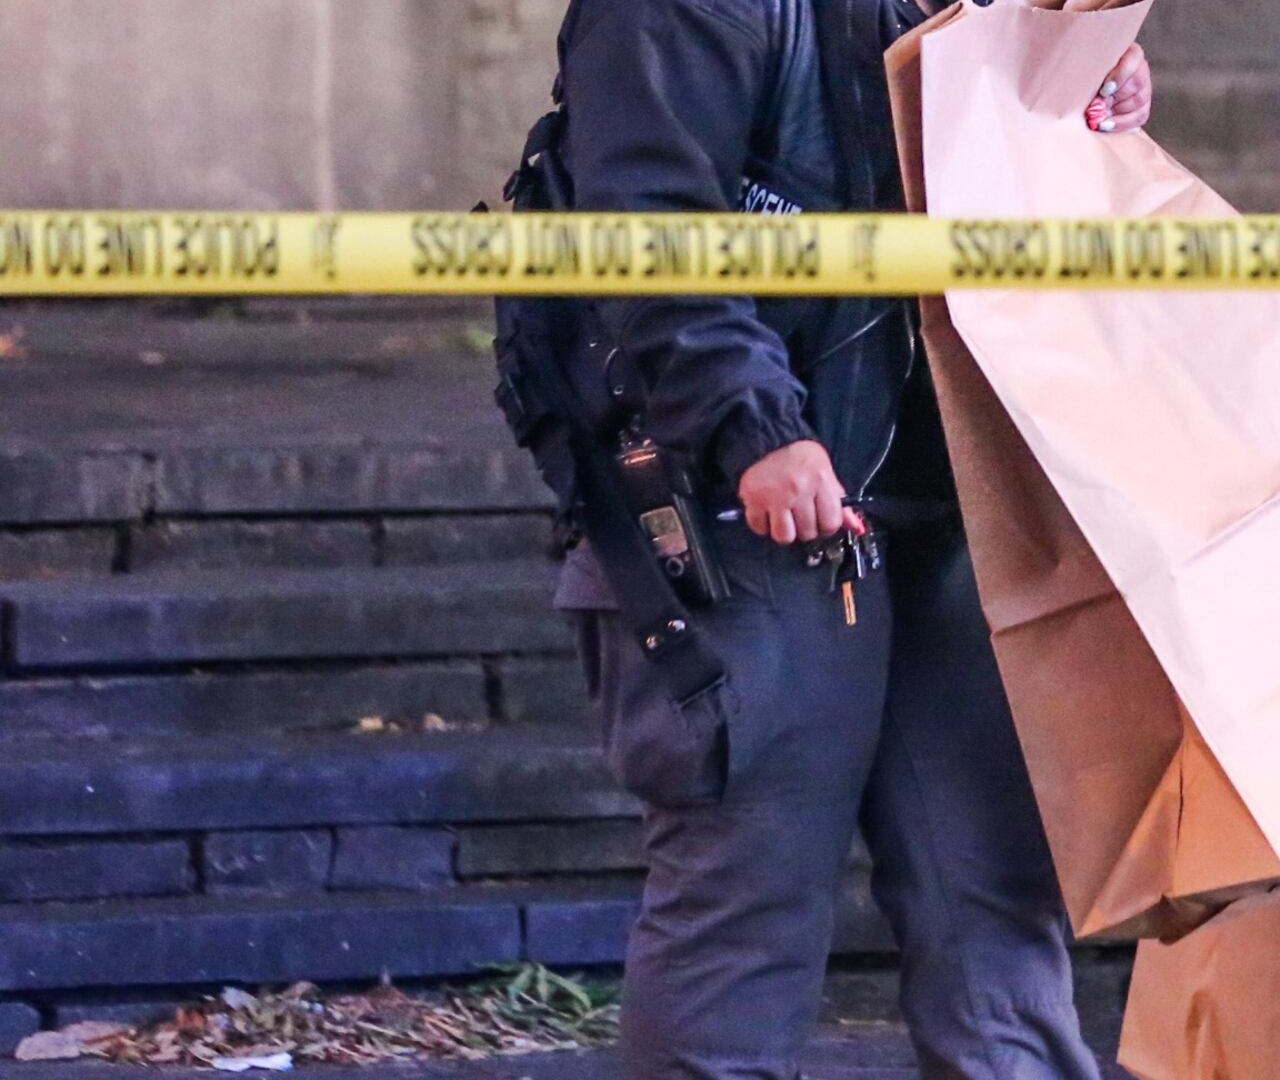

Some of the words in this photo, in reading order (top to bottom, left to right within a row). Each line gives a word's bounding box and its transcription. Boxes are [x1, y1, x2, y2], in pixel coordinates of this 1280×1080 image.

[44, 219, 85, 278] DO
[99, 219, 164, 278] LINE
[175, 219, 279, 278] POLICE
[411, 221, 512, 278] CROSS
[524, 221, 580, 278] NOT
[591, 221, 633, 278] DO
[643, 221, 708, 278] LINE
[717, 221, 820, 278] POLICE
[950, 222, 1049, 279] CROSS
[1058, 222, 1114, 279] NOT
[1125, 222, 1166, 279] DO
[1175, 222, 1239, 279] LINE
